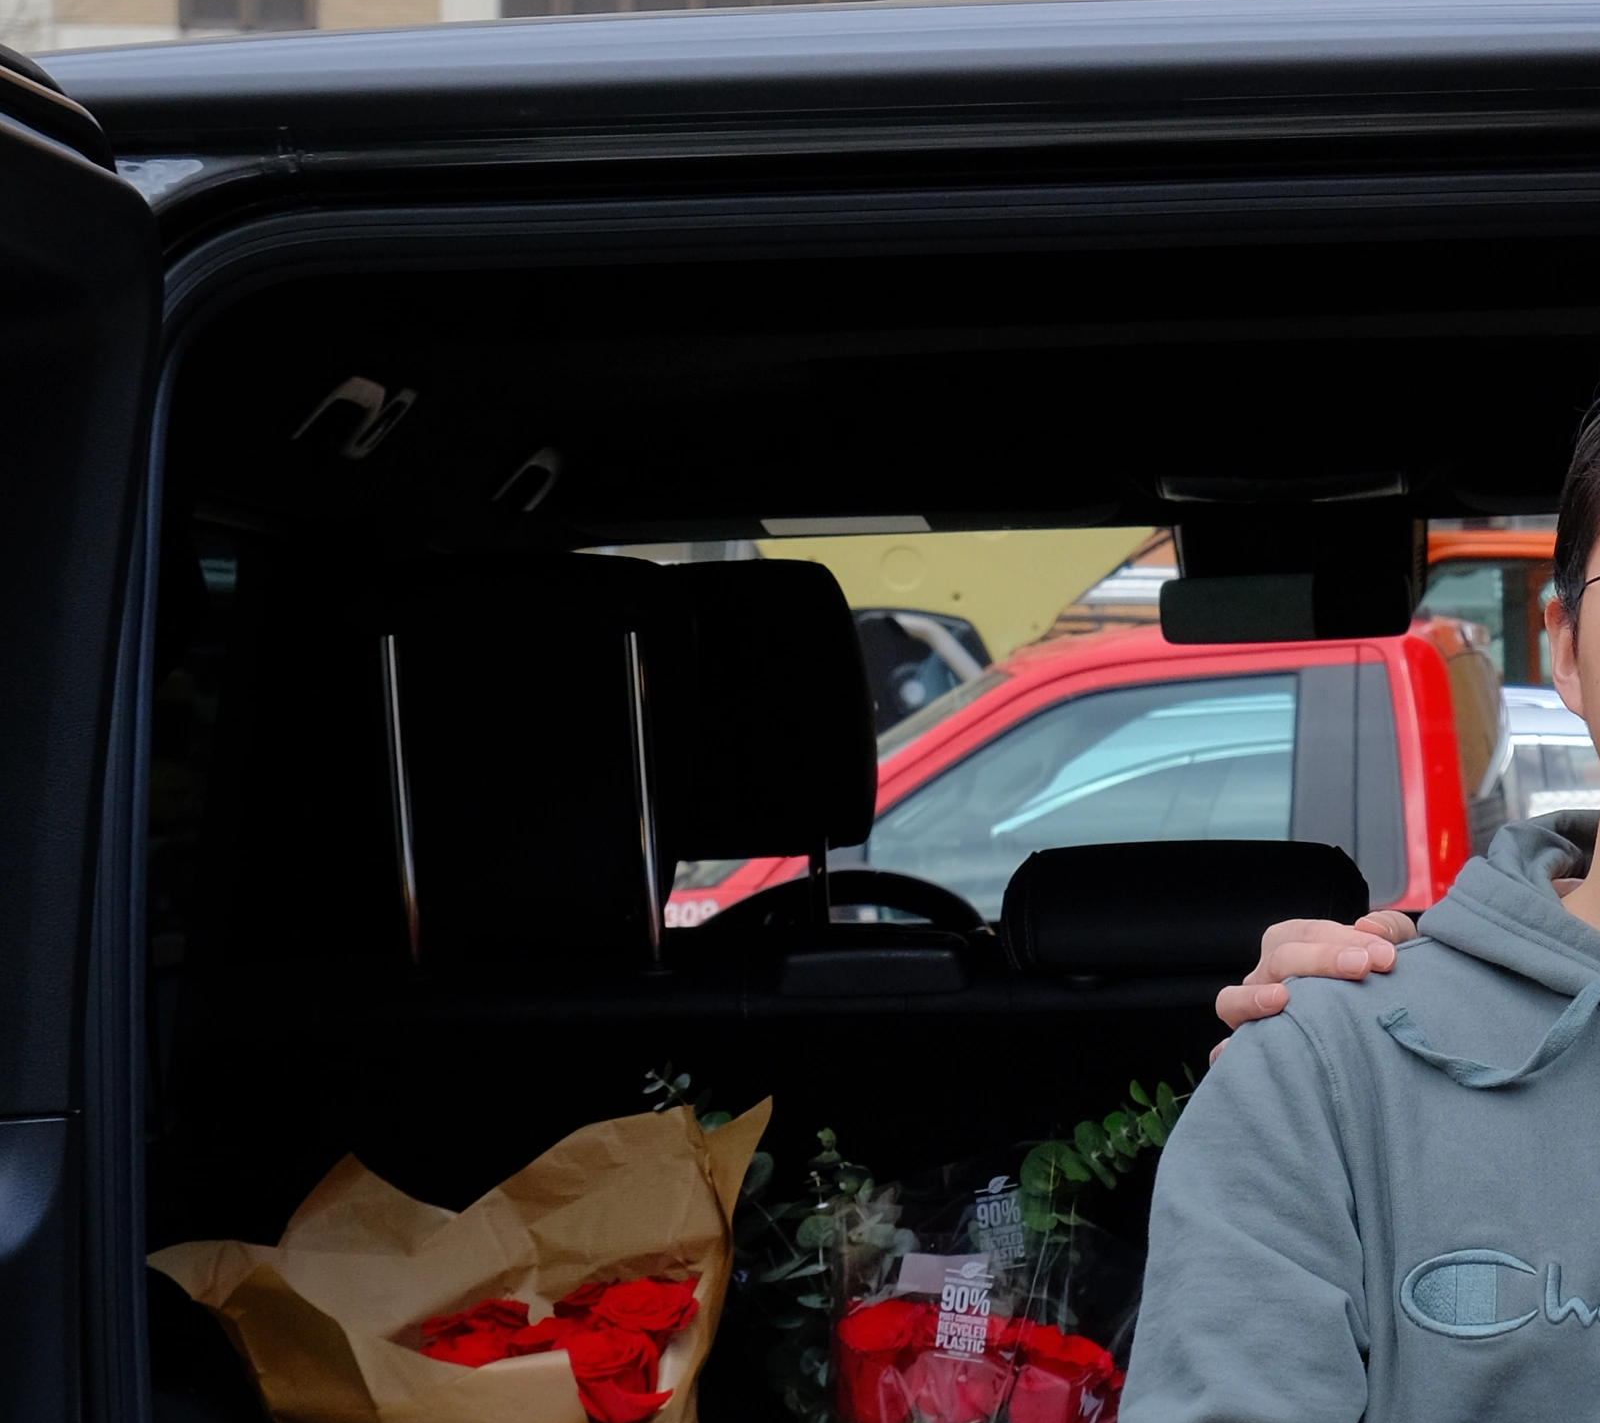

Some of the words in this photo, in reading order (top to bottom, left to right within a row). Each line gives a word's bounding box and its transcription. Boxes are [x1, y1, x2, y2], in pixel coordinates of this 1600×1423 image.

[977, 1198, 1021, 1229] 90%
[940, 1284, 991, 1317] 90%
[937, 1321, 988, 1340] RECYCLED
[935, 1334, 986, 1354] PLASTIC
